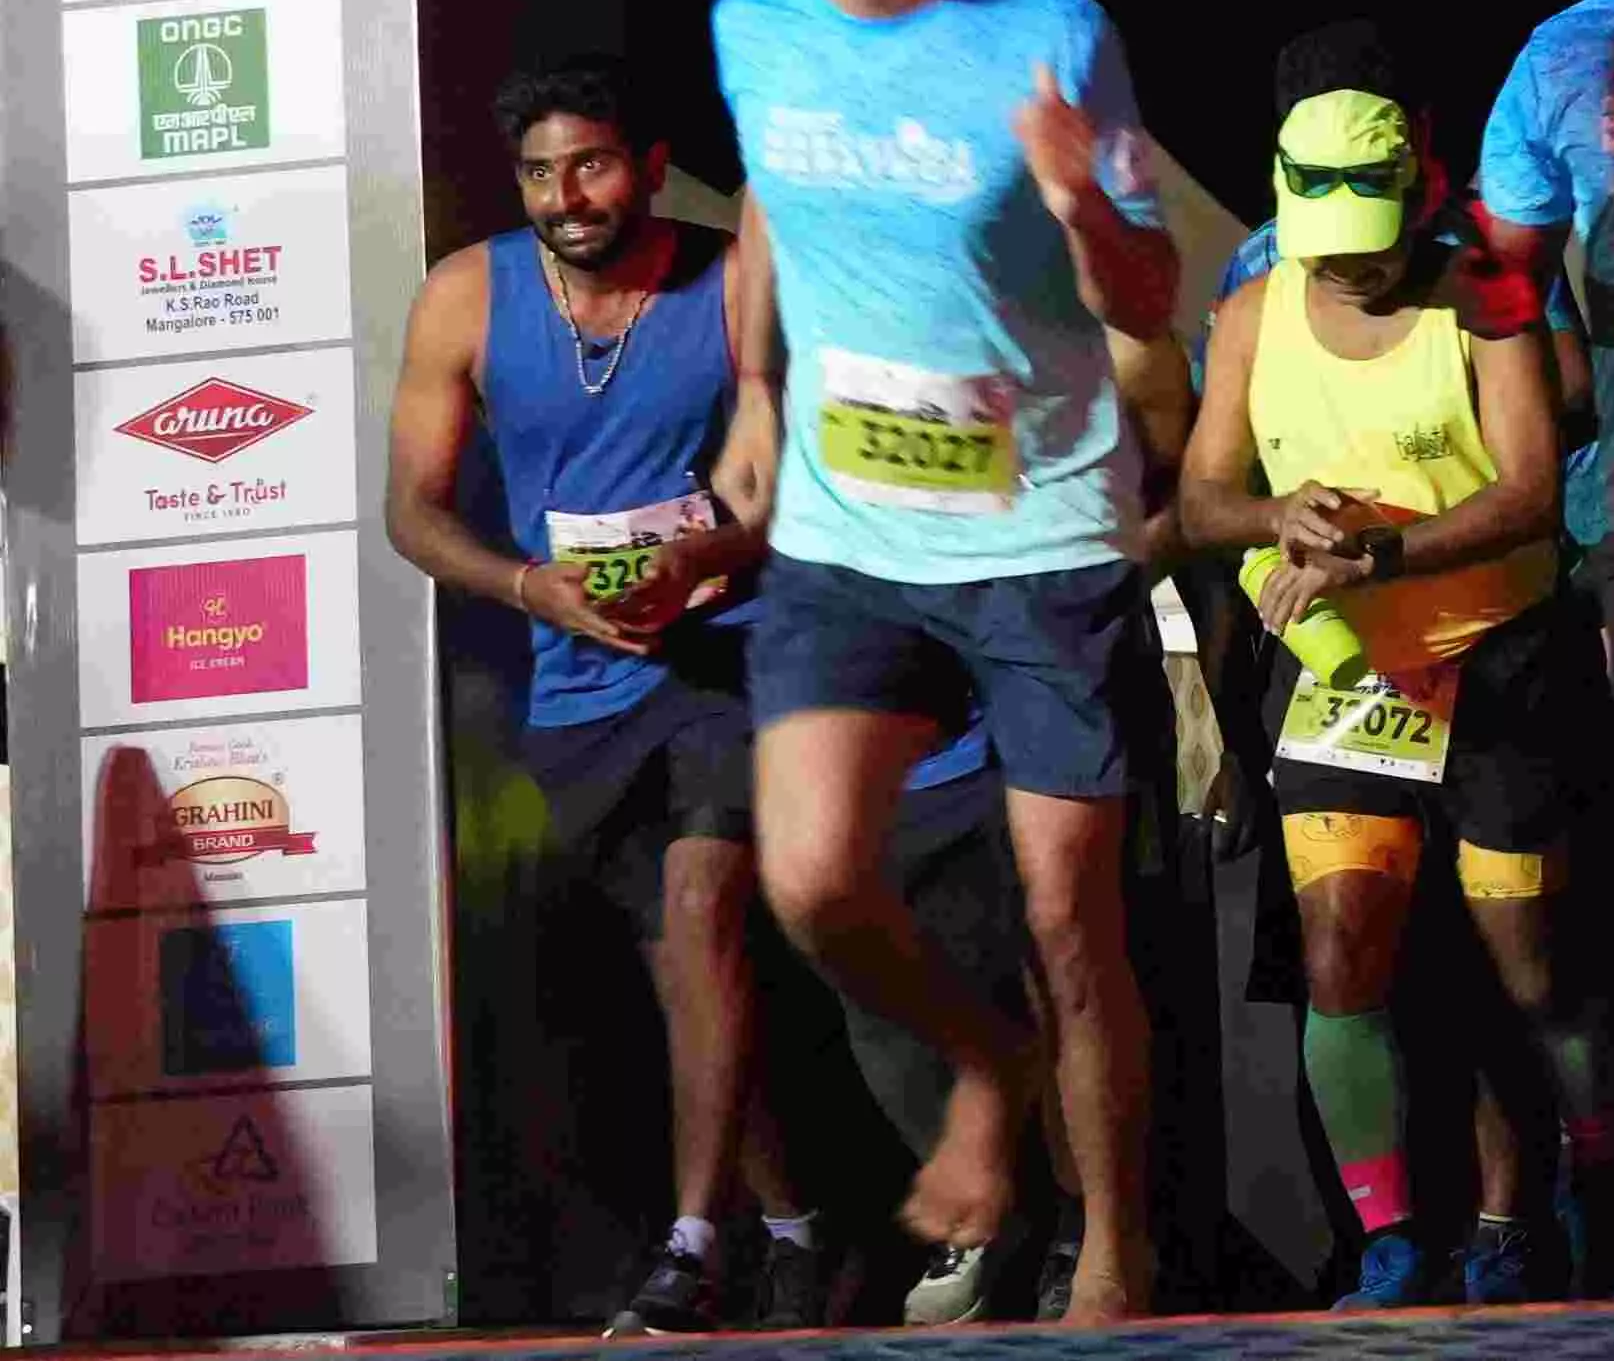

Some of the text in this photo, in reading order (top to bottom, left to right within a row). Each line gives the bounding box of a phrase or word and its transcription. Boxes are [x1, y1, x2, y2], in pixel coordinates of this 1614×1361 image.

[160, 15, 243, 43] ONGC
[224, 292, 259, 307] Road
[146, 314, 217, 333] Mangalore
[229, 309, 253, 325] 575
[257, 307, 279, 322] 001
[144, 489, 200, 511] Taste
[207, 483, 227, 505] &
[167, 621, 265, 650] Hangyo
[173, 799, 273, 826] GRAHINI
[193, 834, 255, 850] BRAND
